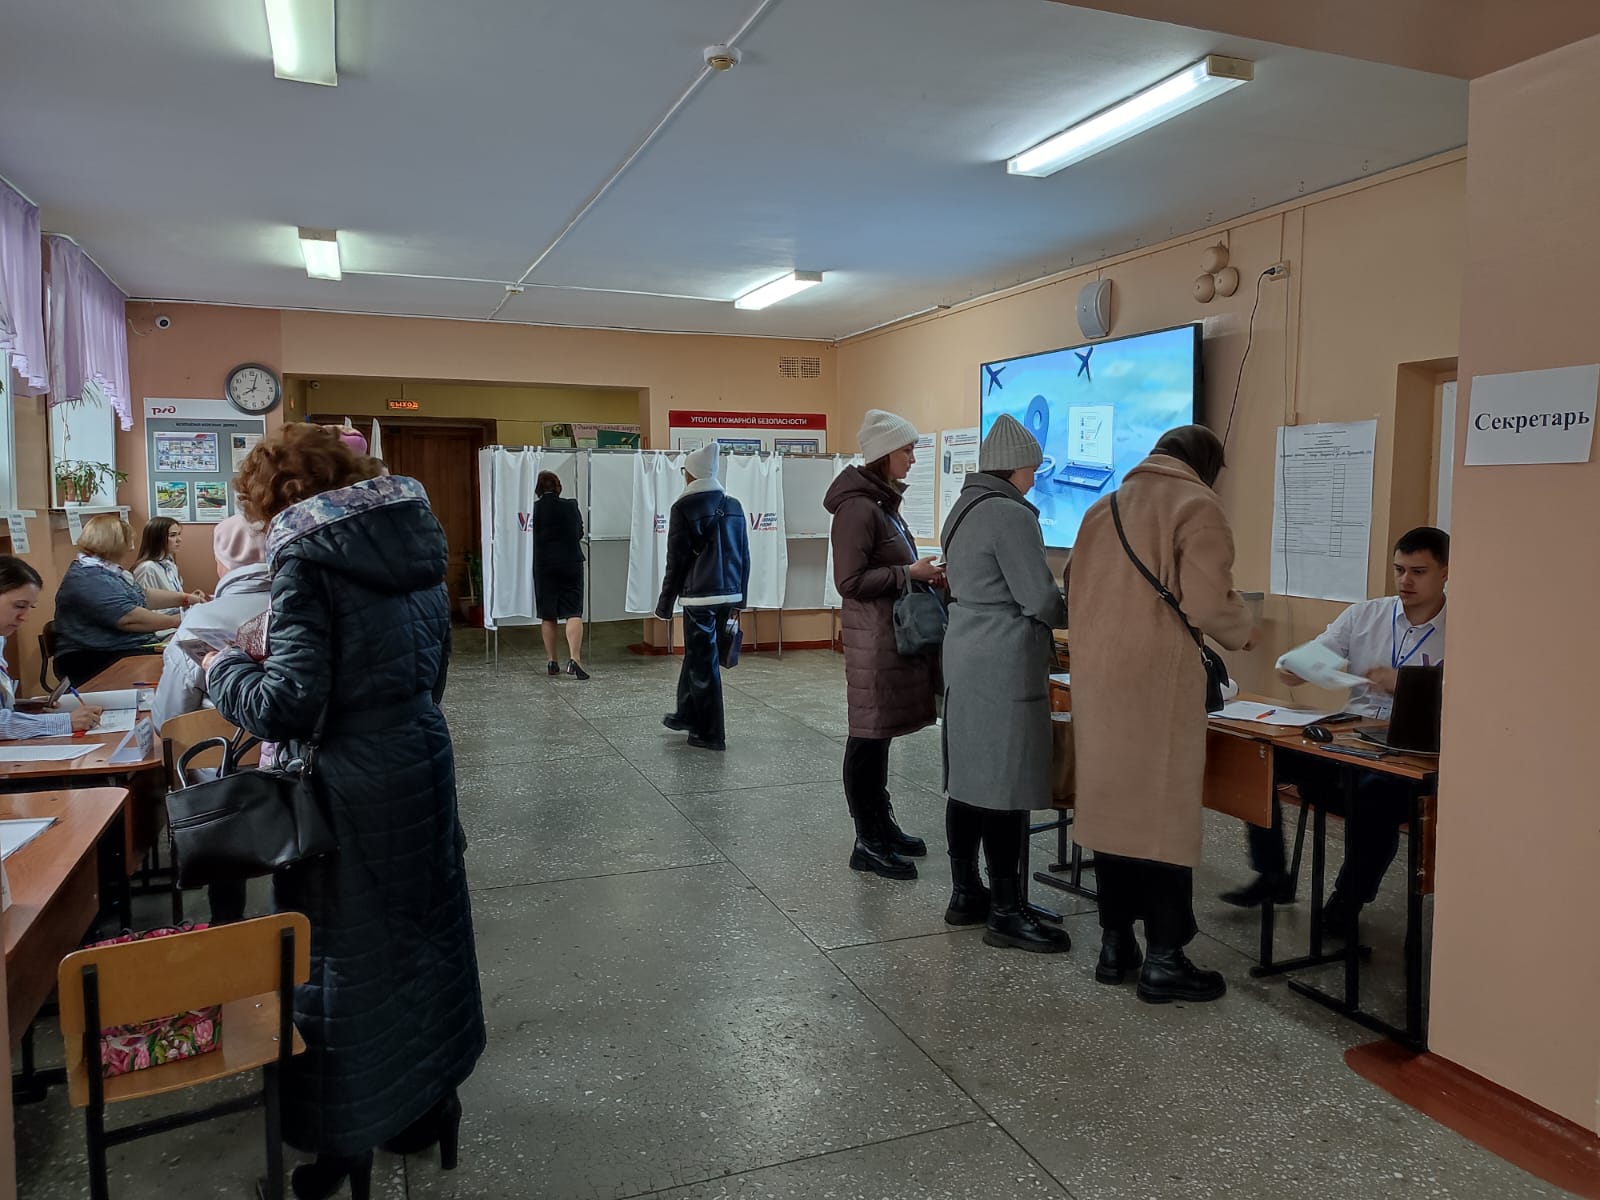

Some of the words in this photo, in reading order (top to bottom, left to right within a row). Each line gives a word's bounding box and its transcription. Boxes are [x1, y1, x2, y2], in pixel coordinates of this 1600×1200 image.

[690, 416, 718, 424] УГОЛОК
[718, 416, 757, 425] ПОЖАРНОЙ
[757, 417, 808, 426] БЕЗОПАСНОСТИ
[1474, 411, 1591, 434] Секретарь
